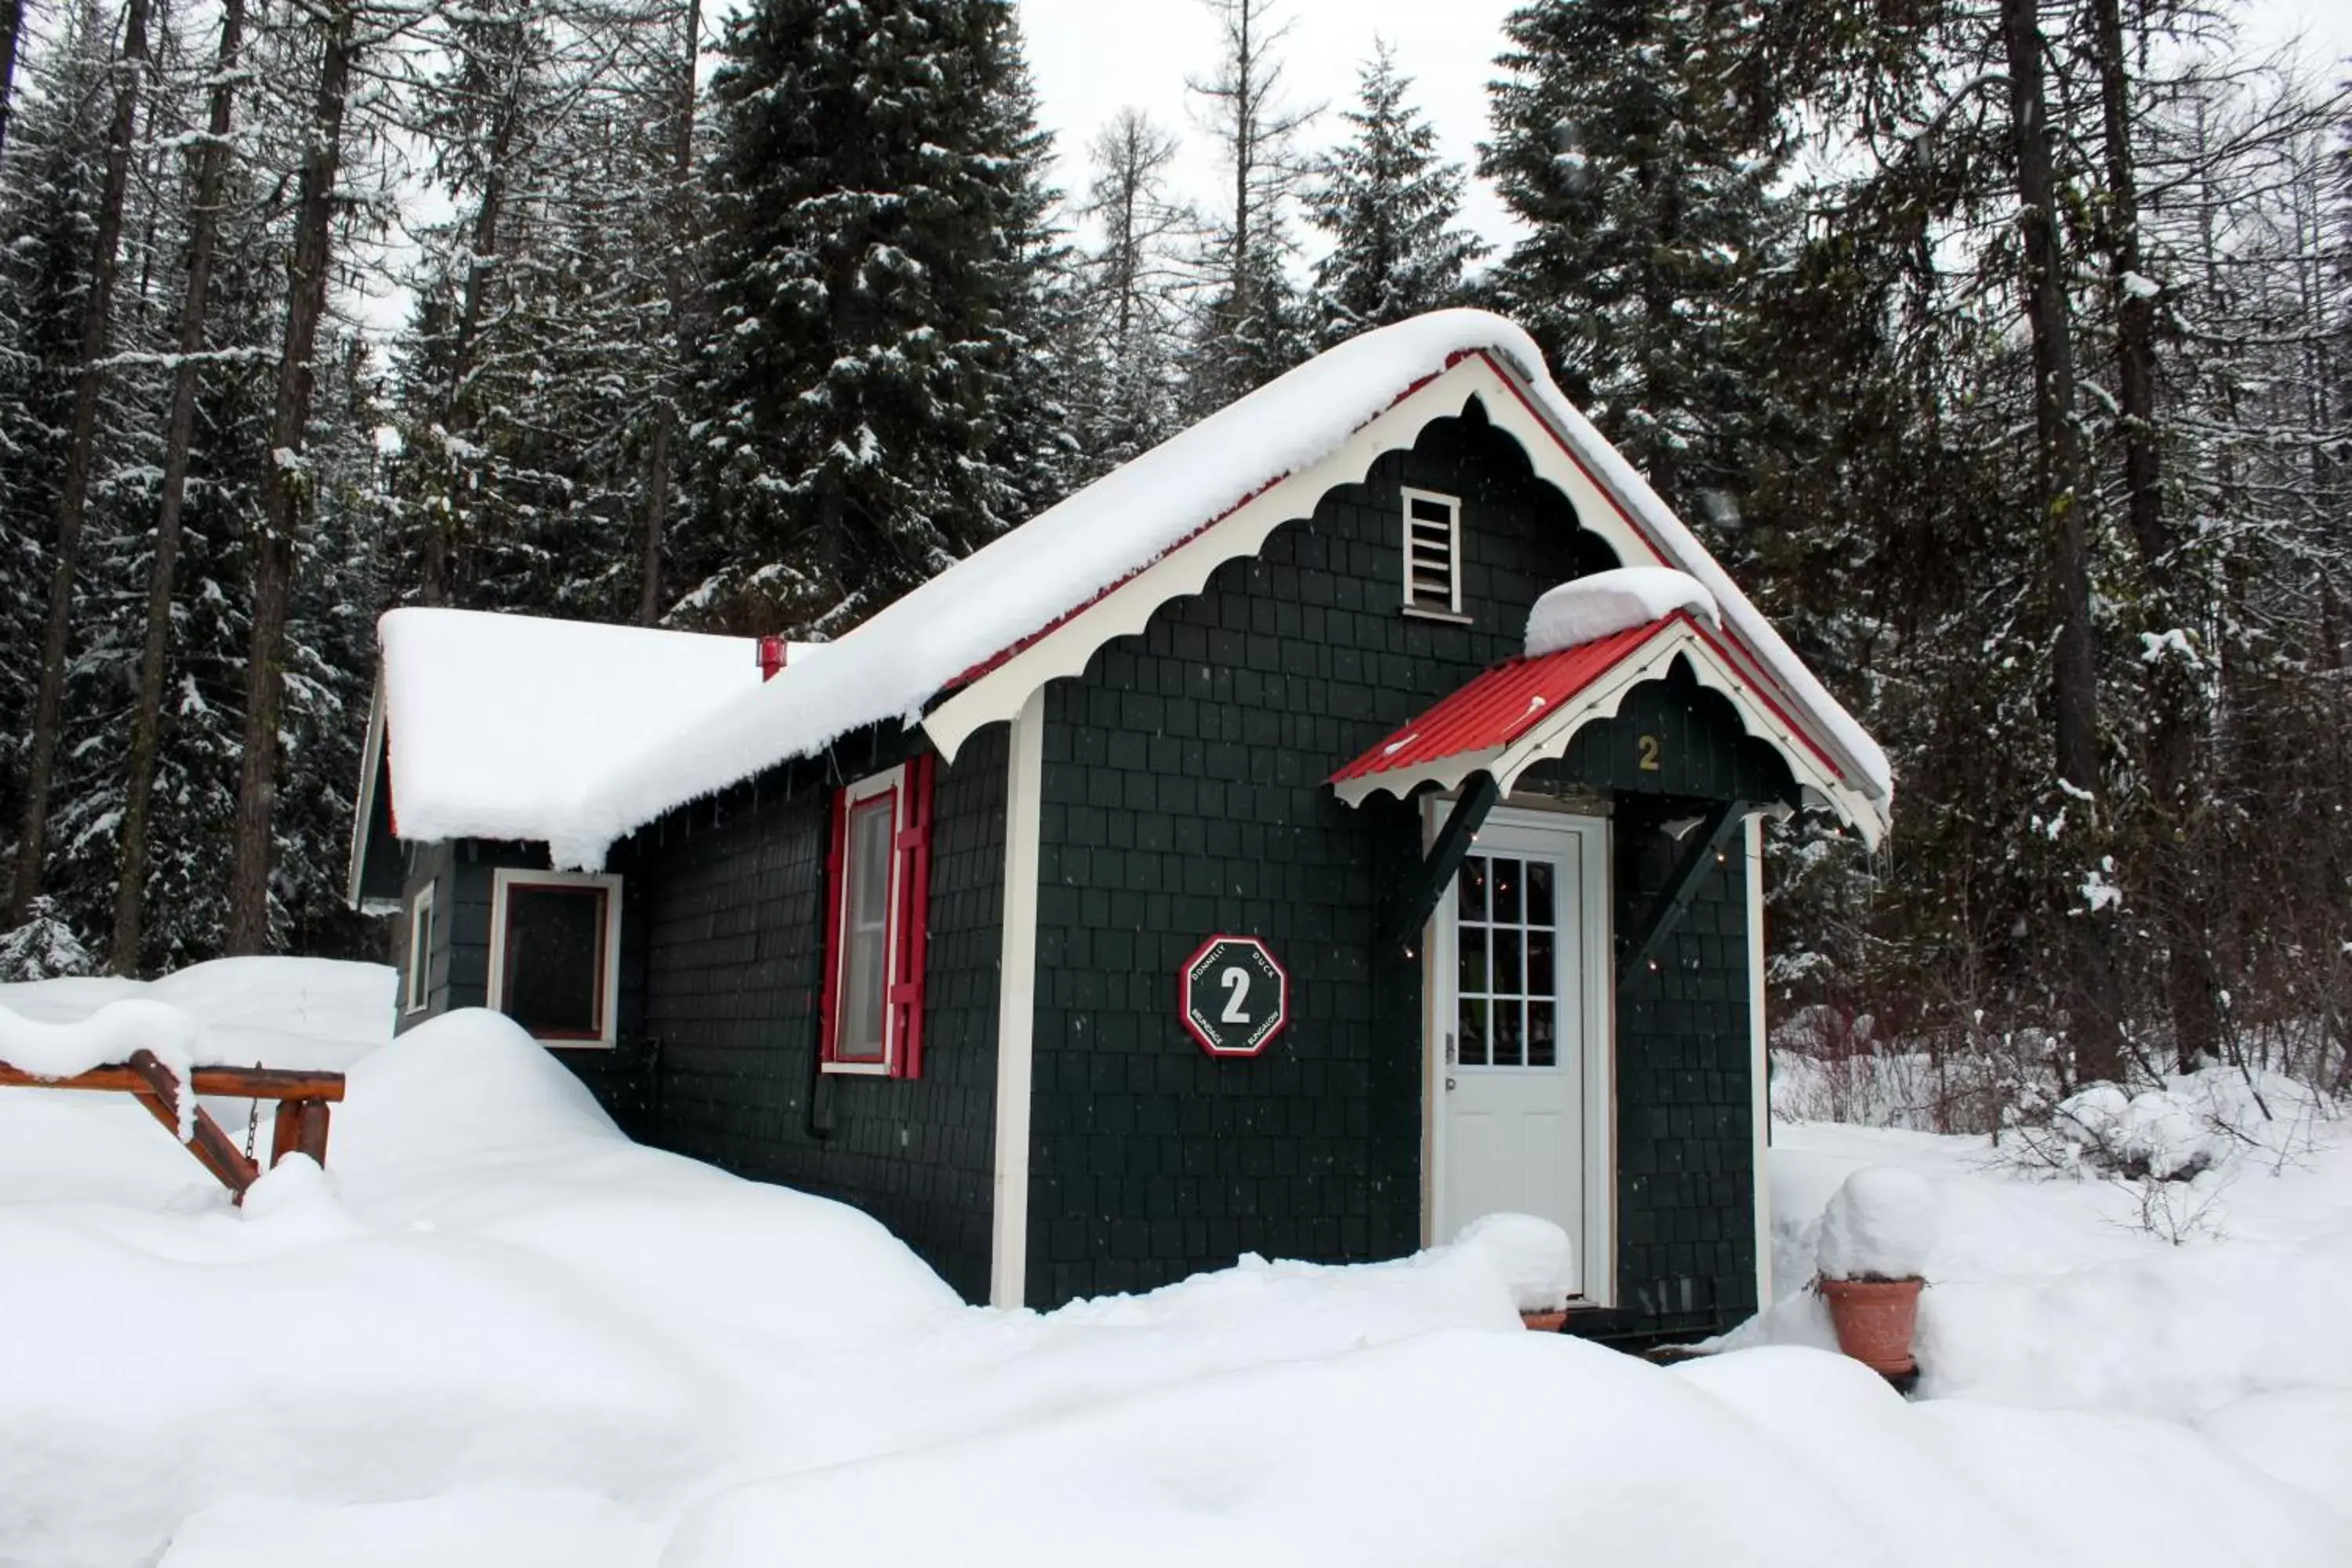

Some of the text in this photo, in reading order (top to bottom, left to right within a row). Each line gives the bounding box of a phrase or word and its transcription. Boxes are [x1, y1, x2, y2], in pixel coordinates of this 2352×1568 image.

[1639, 735, 1659, 770] 2
[1253, 952, 1275, 978] DUCK
[1221, 967, 1250, 1023] 2
